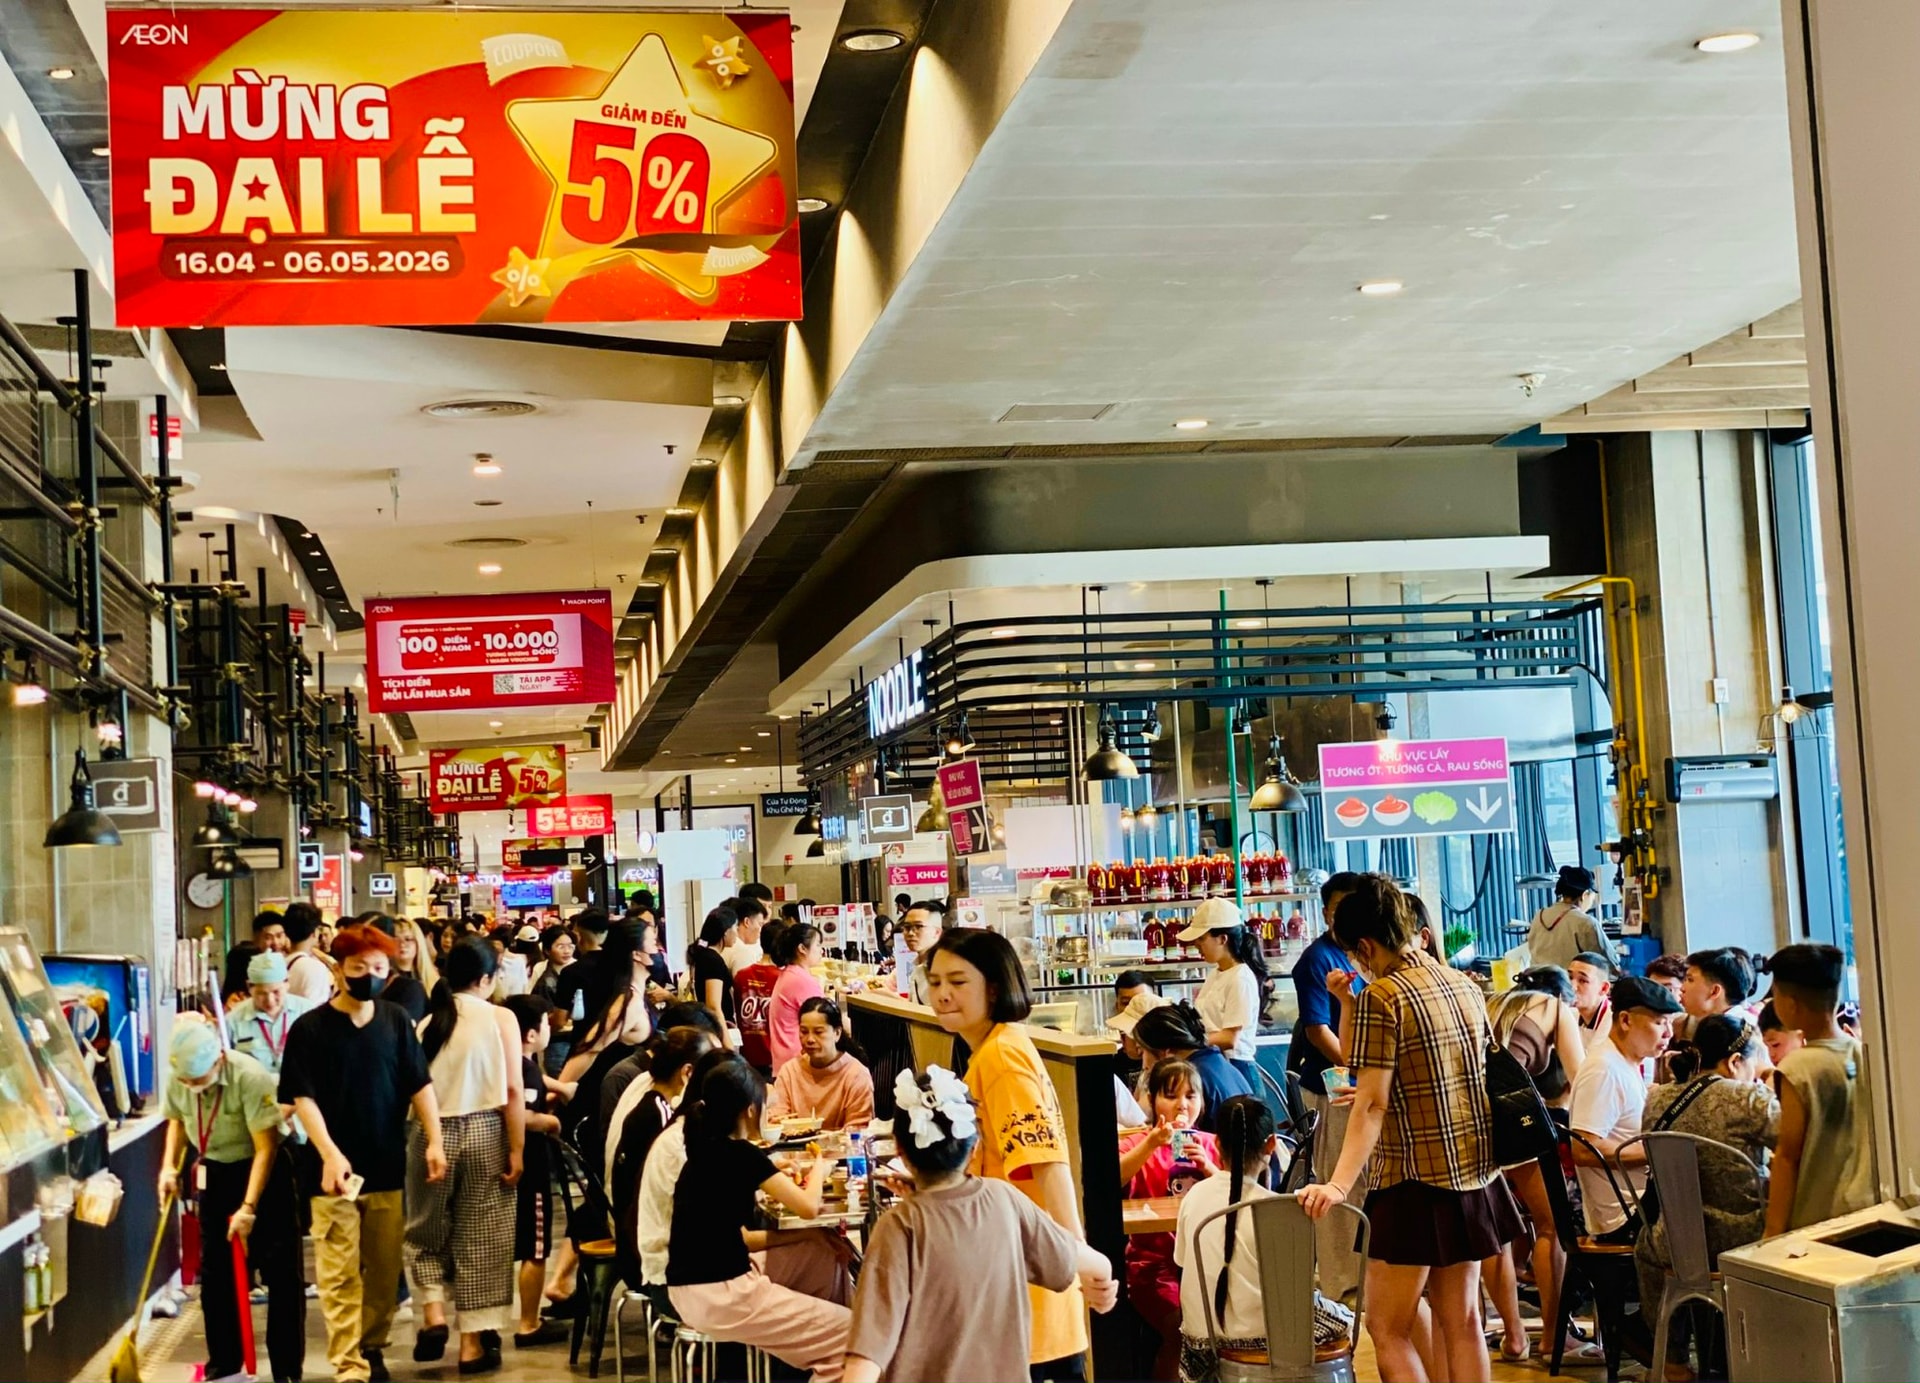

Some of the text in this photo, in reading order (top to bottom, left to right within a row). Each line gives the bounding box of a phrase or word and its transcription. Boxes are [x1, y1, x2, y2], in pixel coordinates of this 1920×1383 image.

[494, 42, 558, 66] COUPON
[162, 69, 390, 141] MỪNG
[601, 103, 687, 129] GIẢM ĐẾN
[144, 117, 476, 244] ĐẠI LỄ
[175, 252, 256, 274] 16.04
[284, 251, 450, 273] 06.05.2026
[397, 635, 437, 654] 100
[483, 630, 558, 650] 10.000
[382, 678, 405, 688] TÍCH
[534, 675, 551, 683] APP
[425, 689, 448, 698] MUA
[868, 647, 925, 739] NOODLE
[1404, 749, 1427, 763] VỰC
[439, 761, 486, 776] MỪNG
[1326, 766, 1365, 778] TƯƠNG
[1447, 761, 1470, 772] RAU
[436, 768, 502, 796] ĐẠI LỄ
[916, 870, 938, 880] KHU
